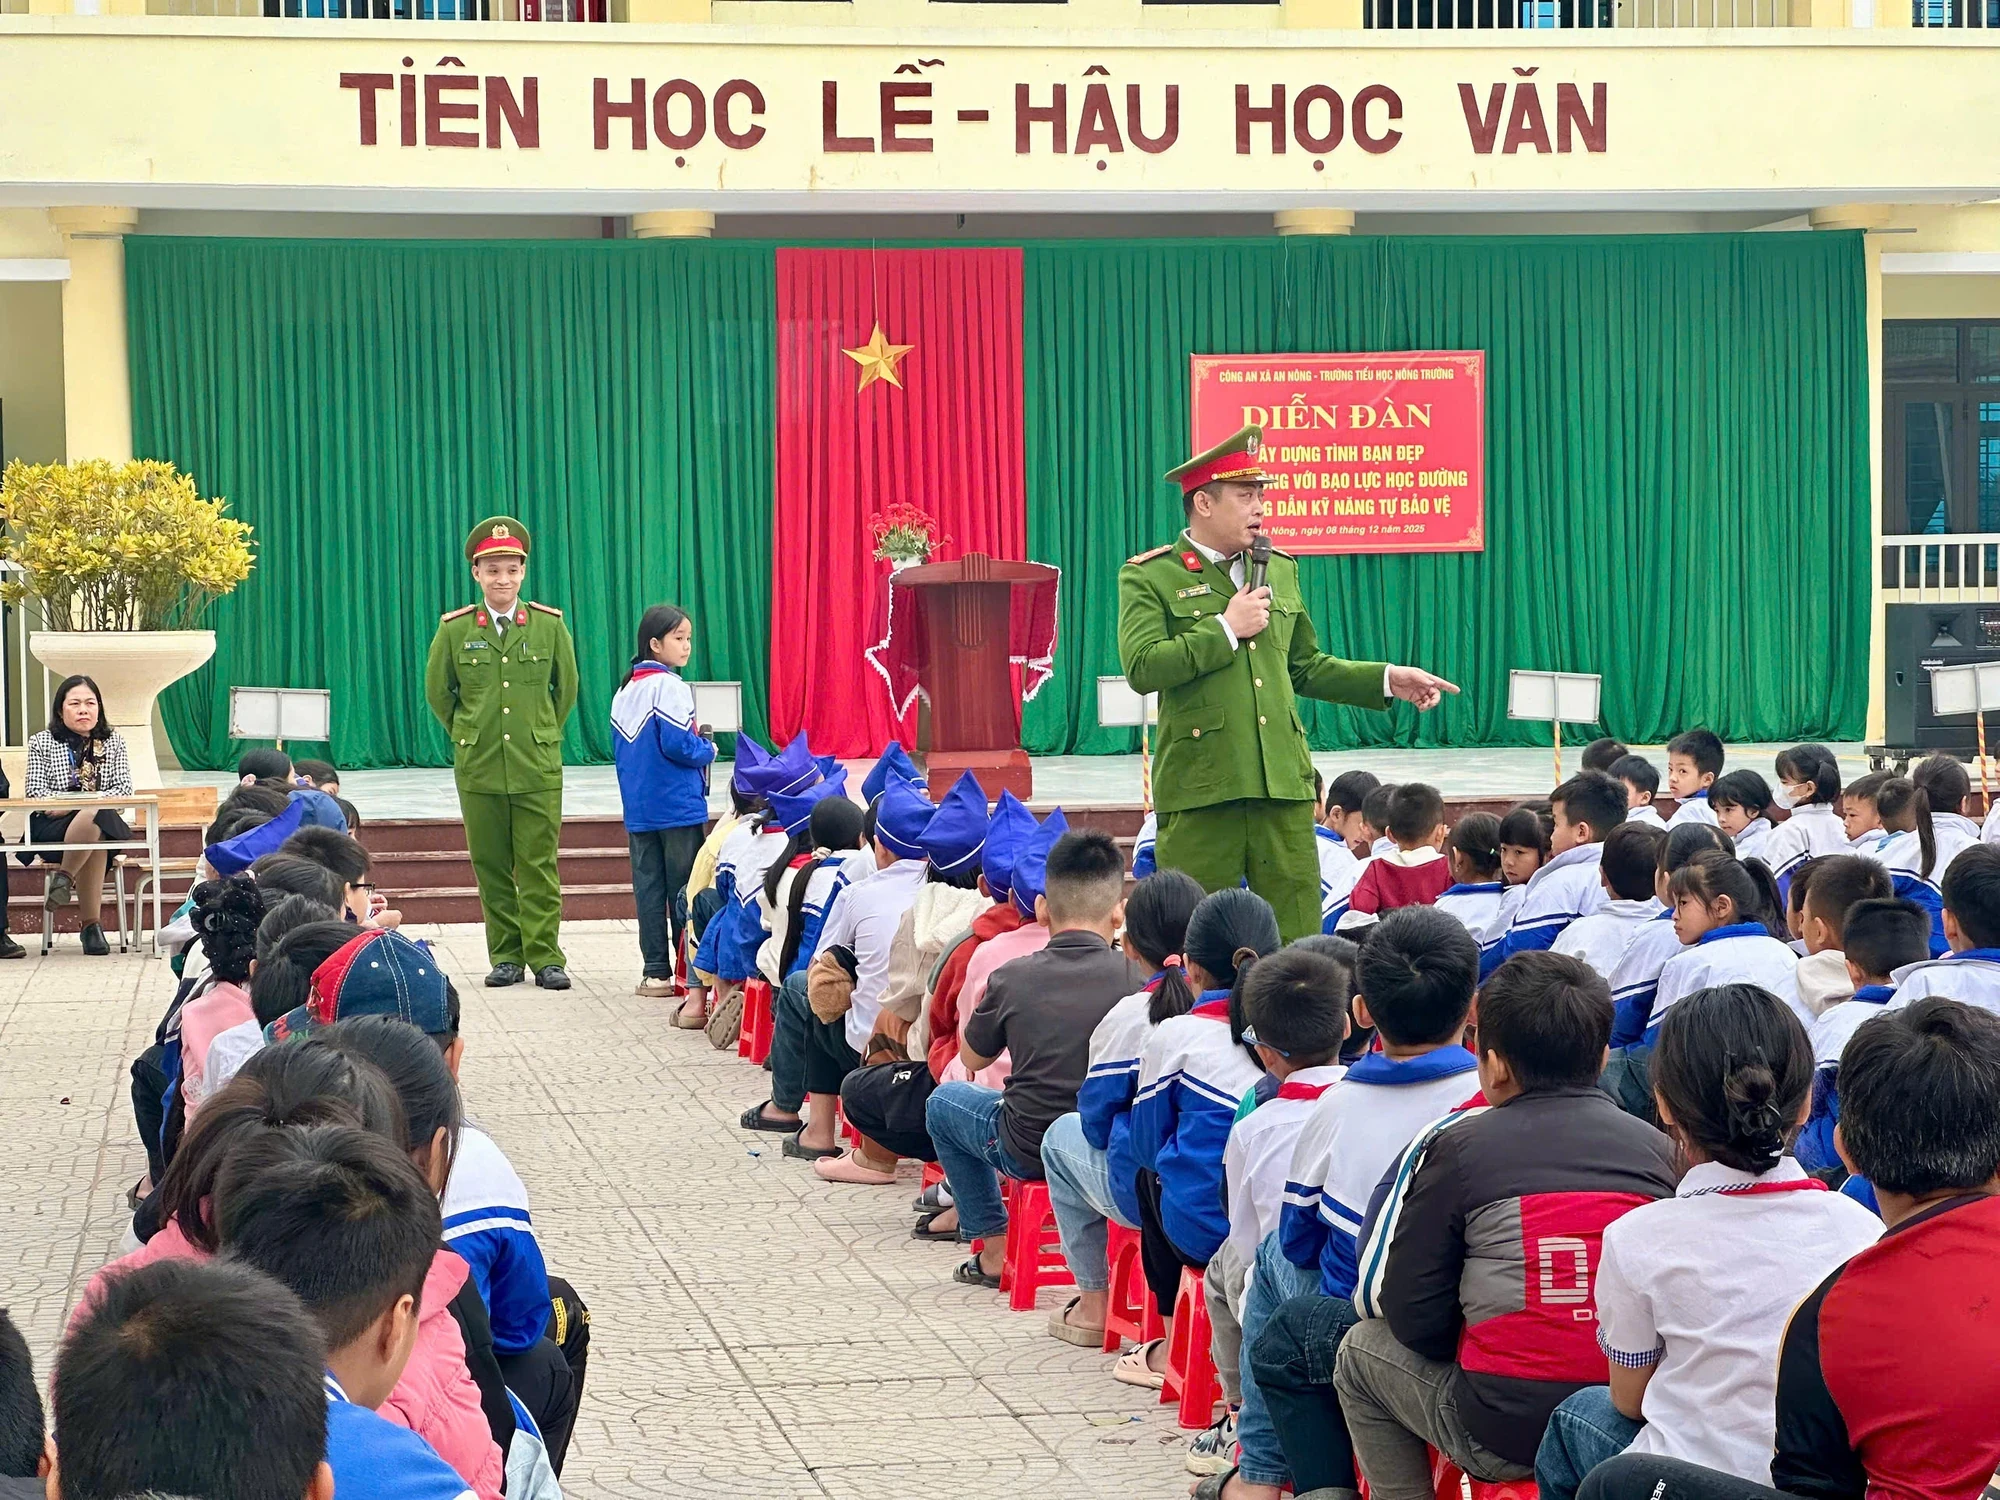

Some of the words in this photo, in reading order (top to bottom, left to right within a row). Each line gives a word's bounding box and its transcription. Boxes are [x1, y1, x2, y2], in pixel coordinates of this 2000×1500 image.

[593, 77, 767, 169] HỌC
[822, 58, 945, 154] LỄ
[957, 109, 990, 122] -
[1015, 64, 1180, 172] HẬU
[1235, 83, 1404, 172] HỌC
[1456, 66, 1609, 156] VĂN
[1219, 369, 1243, 383] CÔNG
[1245, 371, 1258, 383] AN
[1273, 370, 1286, 383] AN
[1287, 368, 1312, 382] NÔNG
[1320, 368, 1354, 382] TRƯỜNG
[1375, 369, 1393, 382] HỌC
[1394, 367, 1419, 380] NÔNG
[1421, 366, 1455, 380] TRƯỜNG
[1241, 393, 1338, 430] DIỄN
[1348, 396, 1433, 429] ĐÀN
[1257, 443, 1277, 464] ÂY
[1281, 445, 1321, 467] DỰNG
[1324, 442, 1358, 463] TÌNH
[1362, 445, 1393, 465] BẠN
[1396, 444, 1425, 465] ĐẸP
[1293, 469, 1317, 490] VỚI
[1321, 473, 1350, 493] BẠO
[1354, 470, 1382, 493] LỰC
[1385, 471, 1415, 492] HỌC
[1418, 467, 1468, 488] ĐƯỜNG
[1277, 493, 1308, 518] DẪN
[1311, 496, 1330, 517] KỸ
[1334, 495, 1375, 516] NĂNG
[1379, 497, 1398, 519] TỰ
[1400, 493, 1430, 515] BẢO
[1433, 494, 1451, 518] VỆ
[1271, 526, 1298, 537] Nông,
[1301, 526, 1324, 536] ngày
[1326, 525, 1337, 535] 08
[1339, 525, 1366, 536] tháng
[1369, 524, 1379, 534] 12
[1381, 524, 1401, 534] năm
[1403, 524, 1425, 533] 2025
